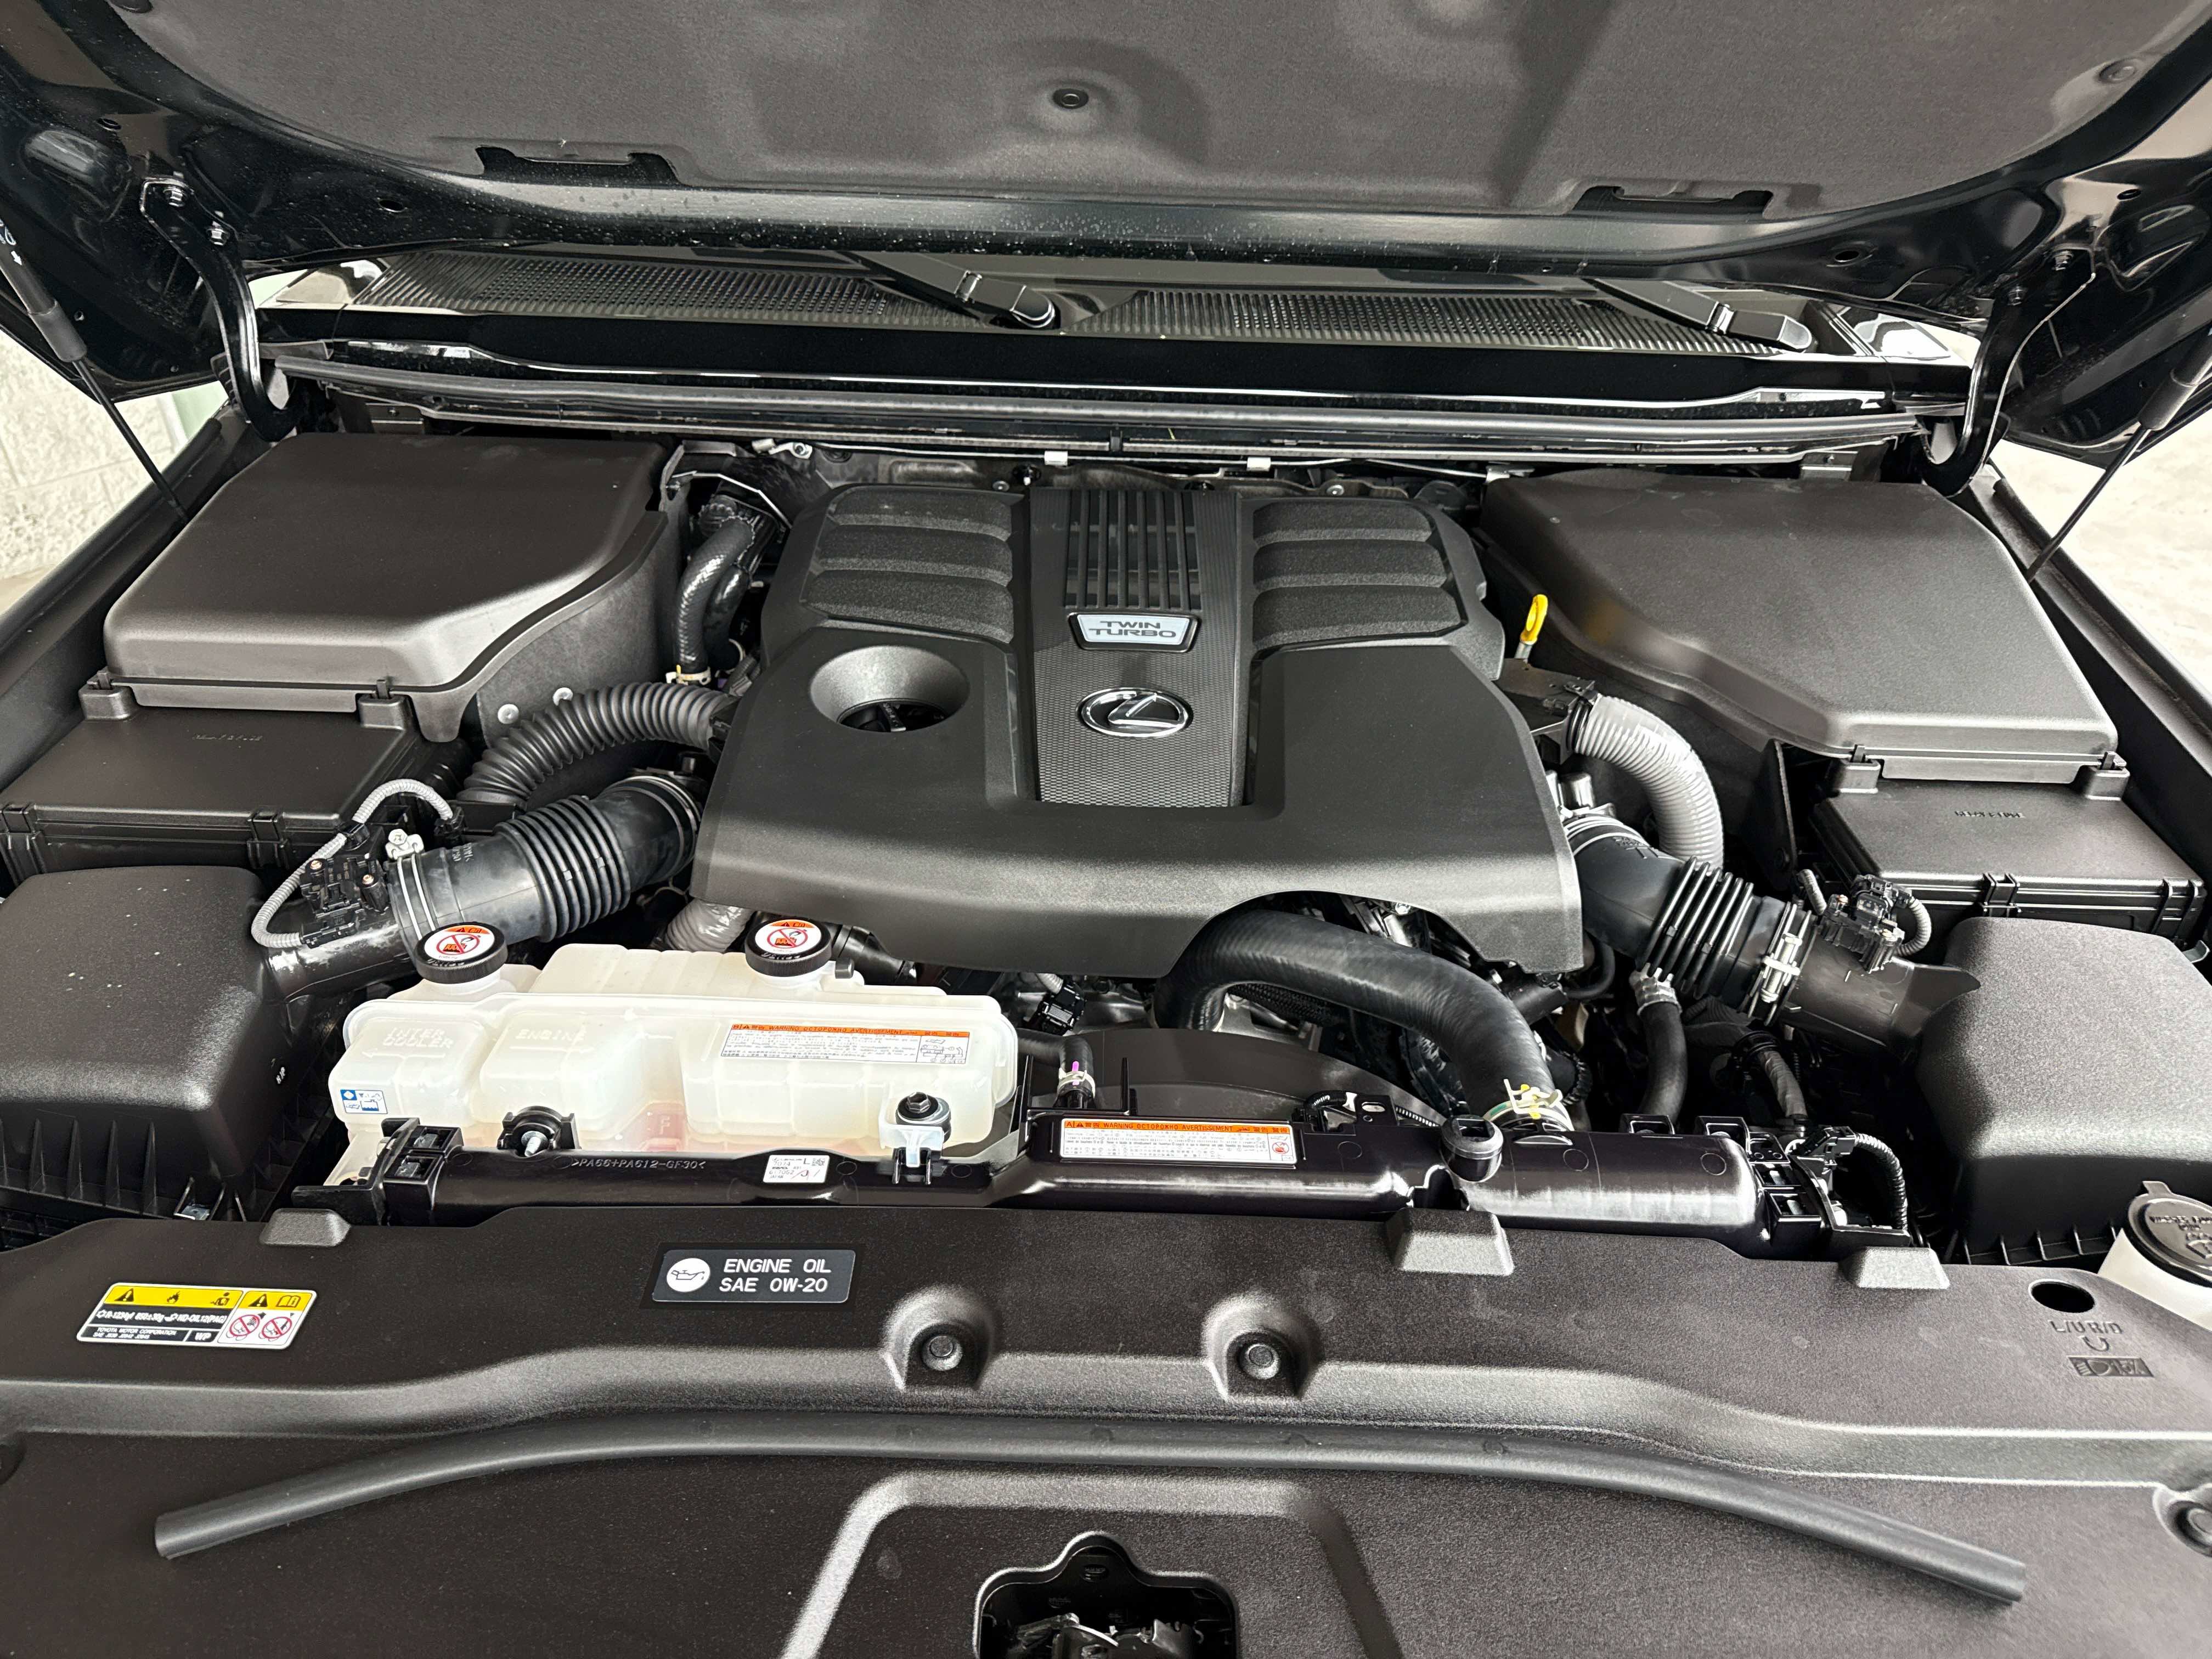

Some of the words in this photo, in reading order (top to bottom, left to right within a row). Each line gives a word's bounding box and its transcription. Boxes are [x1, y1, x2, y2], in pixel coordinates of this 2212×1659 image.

[1100, 620, 1161, 629] TWIN
[1088, 629, 1176, 637] TURBO
[386, 1027, 445, 1037] INTER
[515, 1028, 587, 1041] ENGINE
[382, 1035, 454, 1048] COOLER
[724, 1259, 792, 1273] ENGINE
[803, 1259, 832, 1273] OIL
[719, 1277, 759, 1293] SAE
[769, 1278, 829, 1293] 0W-20
[2047, 1319, 2086, 1333] L/U
[195, 1332, 212, 1341] WP
